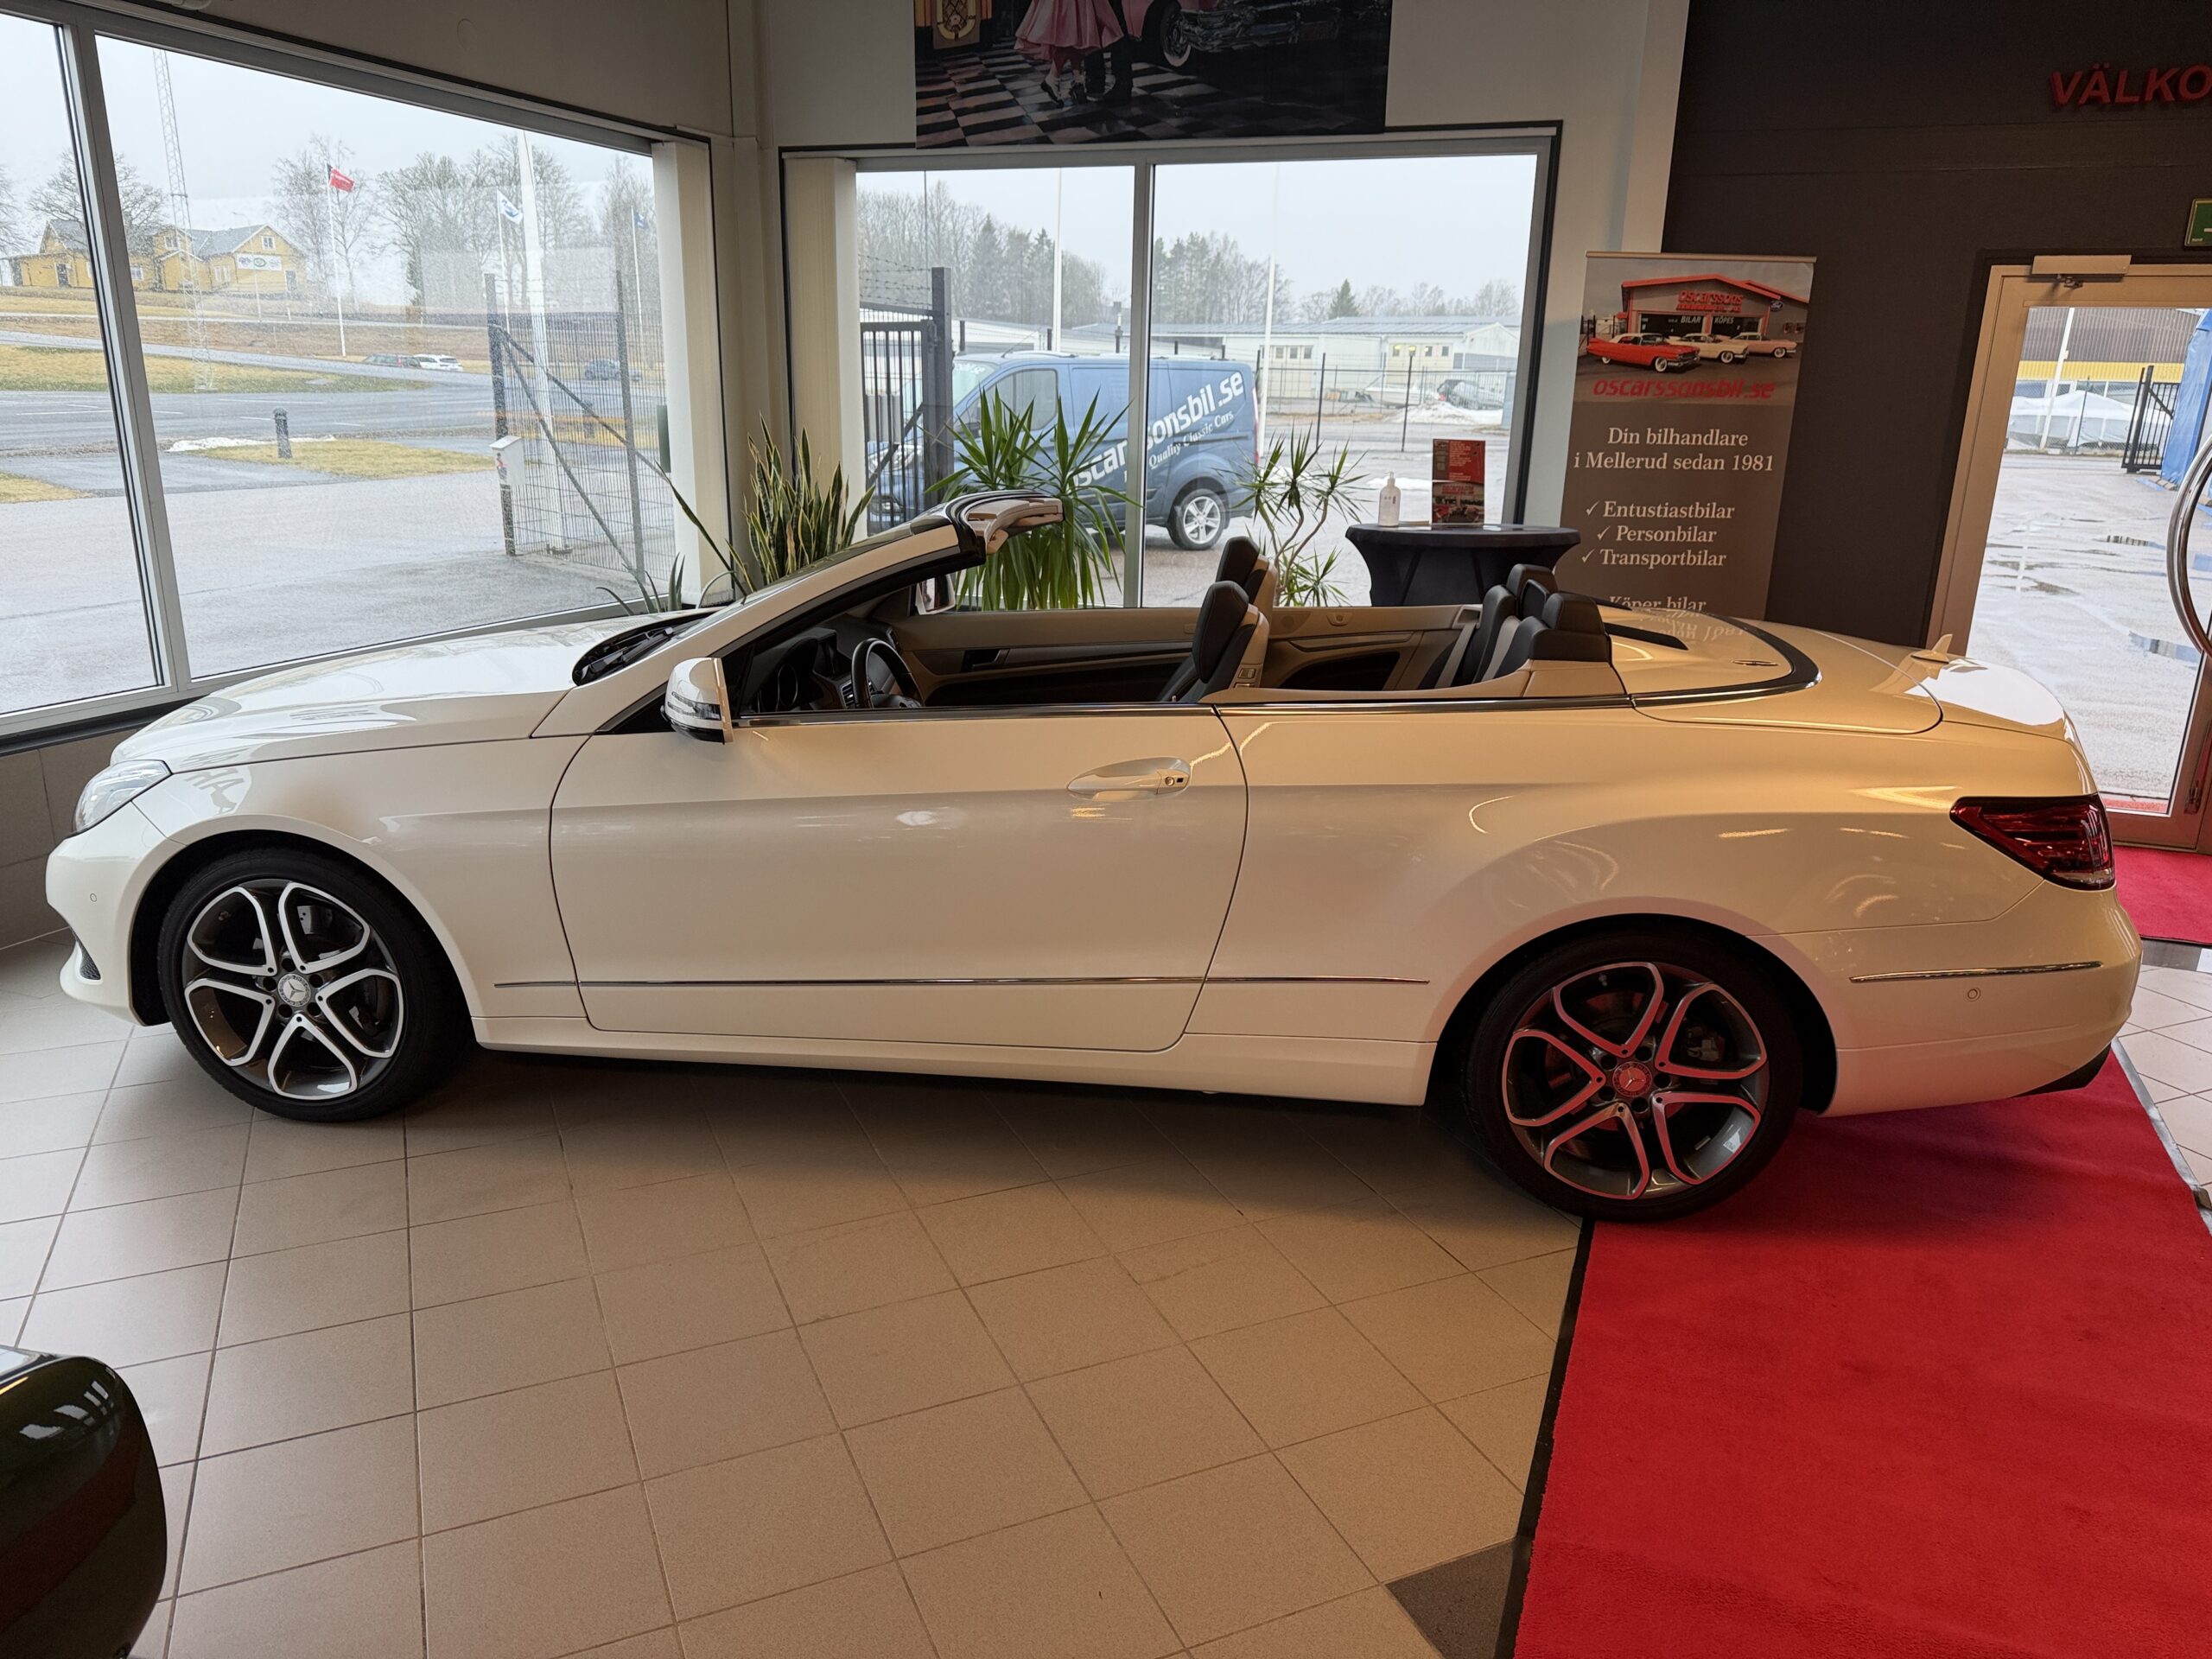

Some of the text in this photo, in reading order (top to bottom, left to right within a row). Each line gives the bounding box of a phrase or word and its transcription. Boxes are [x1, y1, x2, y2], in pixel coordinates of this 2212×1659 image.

[1592, 378, 1776, 399] oscarssonsbil.se
[1148, 410, 1235, 470] Quality Classic Cars
[1607, 427, 1749, 447] Din bilhandlare
[1573, 451, 1773, 472] i Mellerud sedan 1981
[1603, 500, 1735, 519] Entustiastbilar
[1616, 524, 1717, 543] Personbilar
[1599, 549, 1726, 569] Transportbilar
[1667, 596, 1707, 612] bilar
